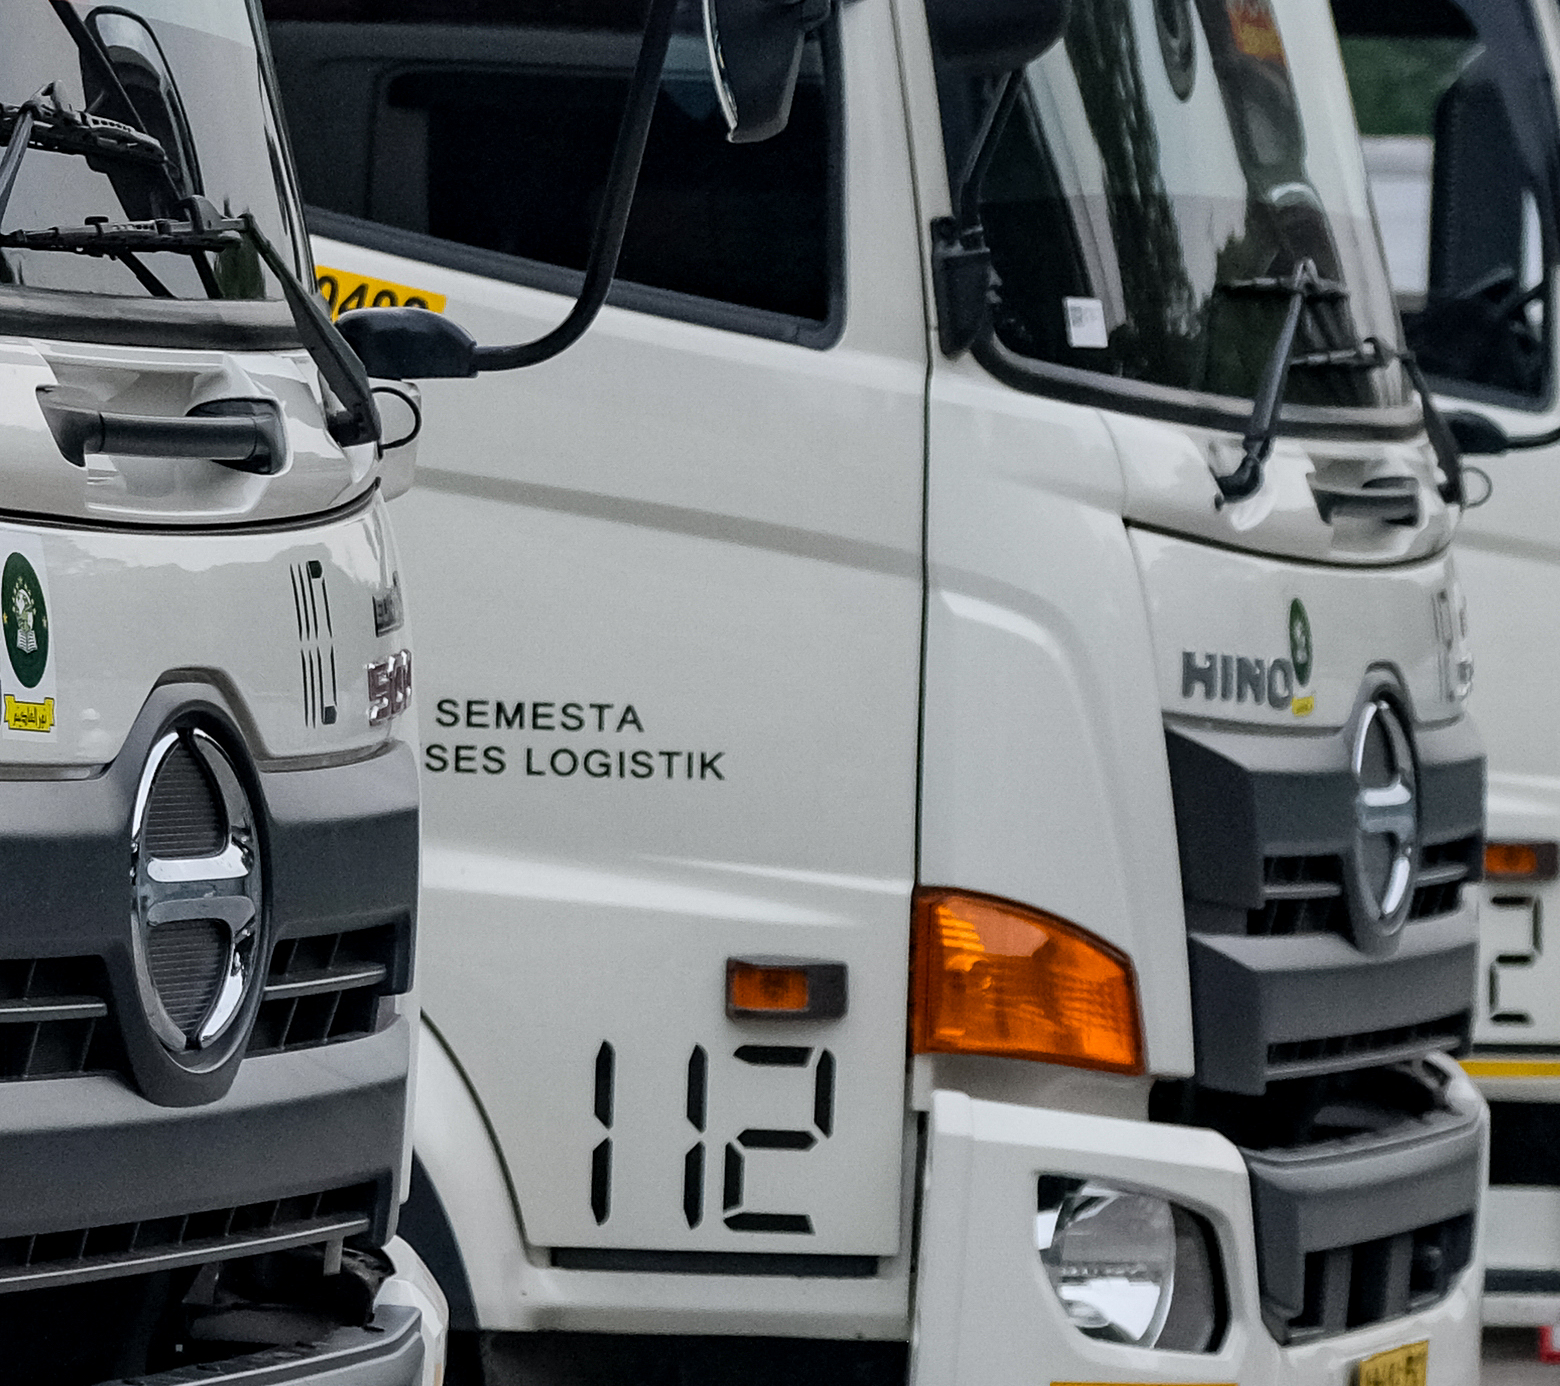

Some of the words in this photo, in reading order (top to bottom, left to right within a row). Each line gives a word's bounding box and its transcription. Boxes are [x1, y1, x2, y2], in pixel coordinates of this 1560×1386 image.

[1181, 651, 1294, 710] HINO
[435, 698, 645, 733] SEMESTA
[424, 743, 507, 775] SES
[525, 747, 726, 781] LOGISTIK
[1488, 893, 1543, 1026] 2
[591, 1040, 836, 1235] 112
